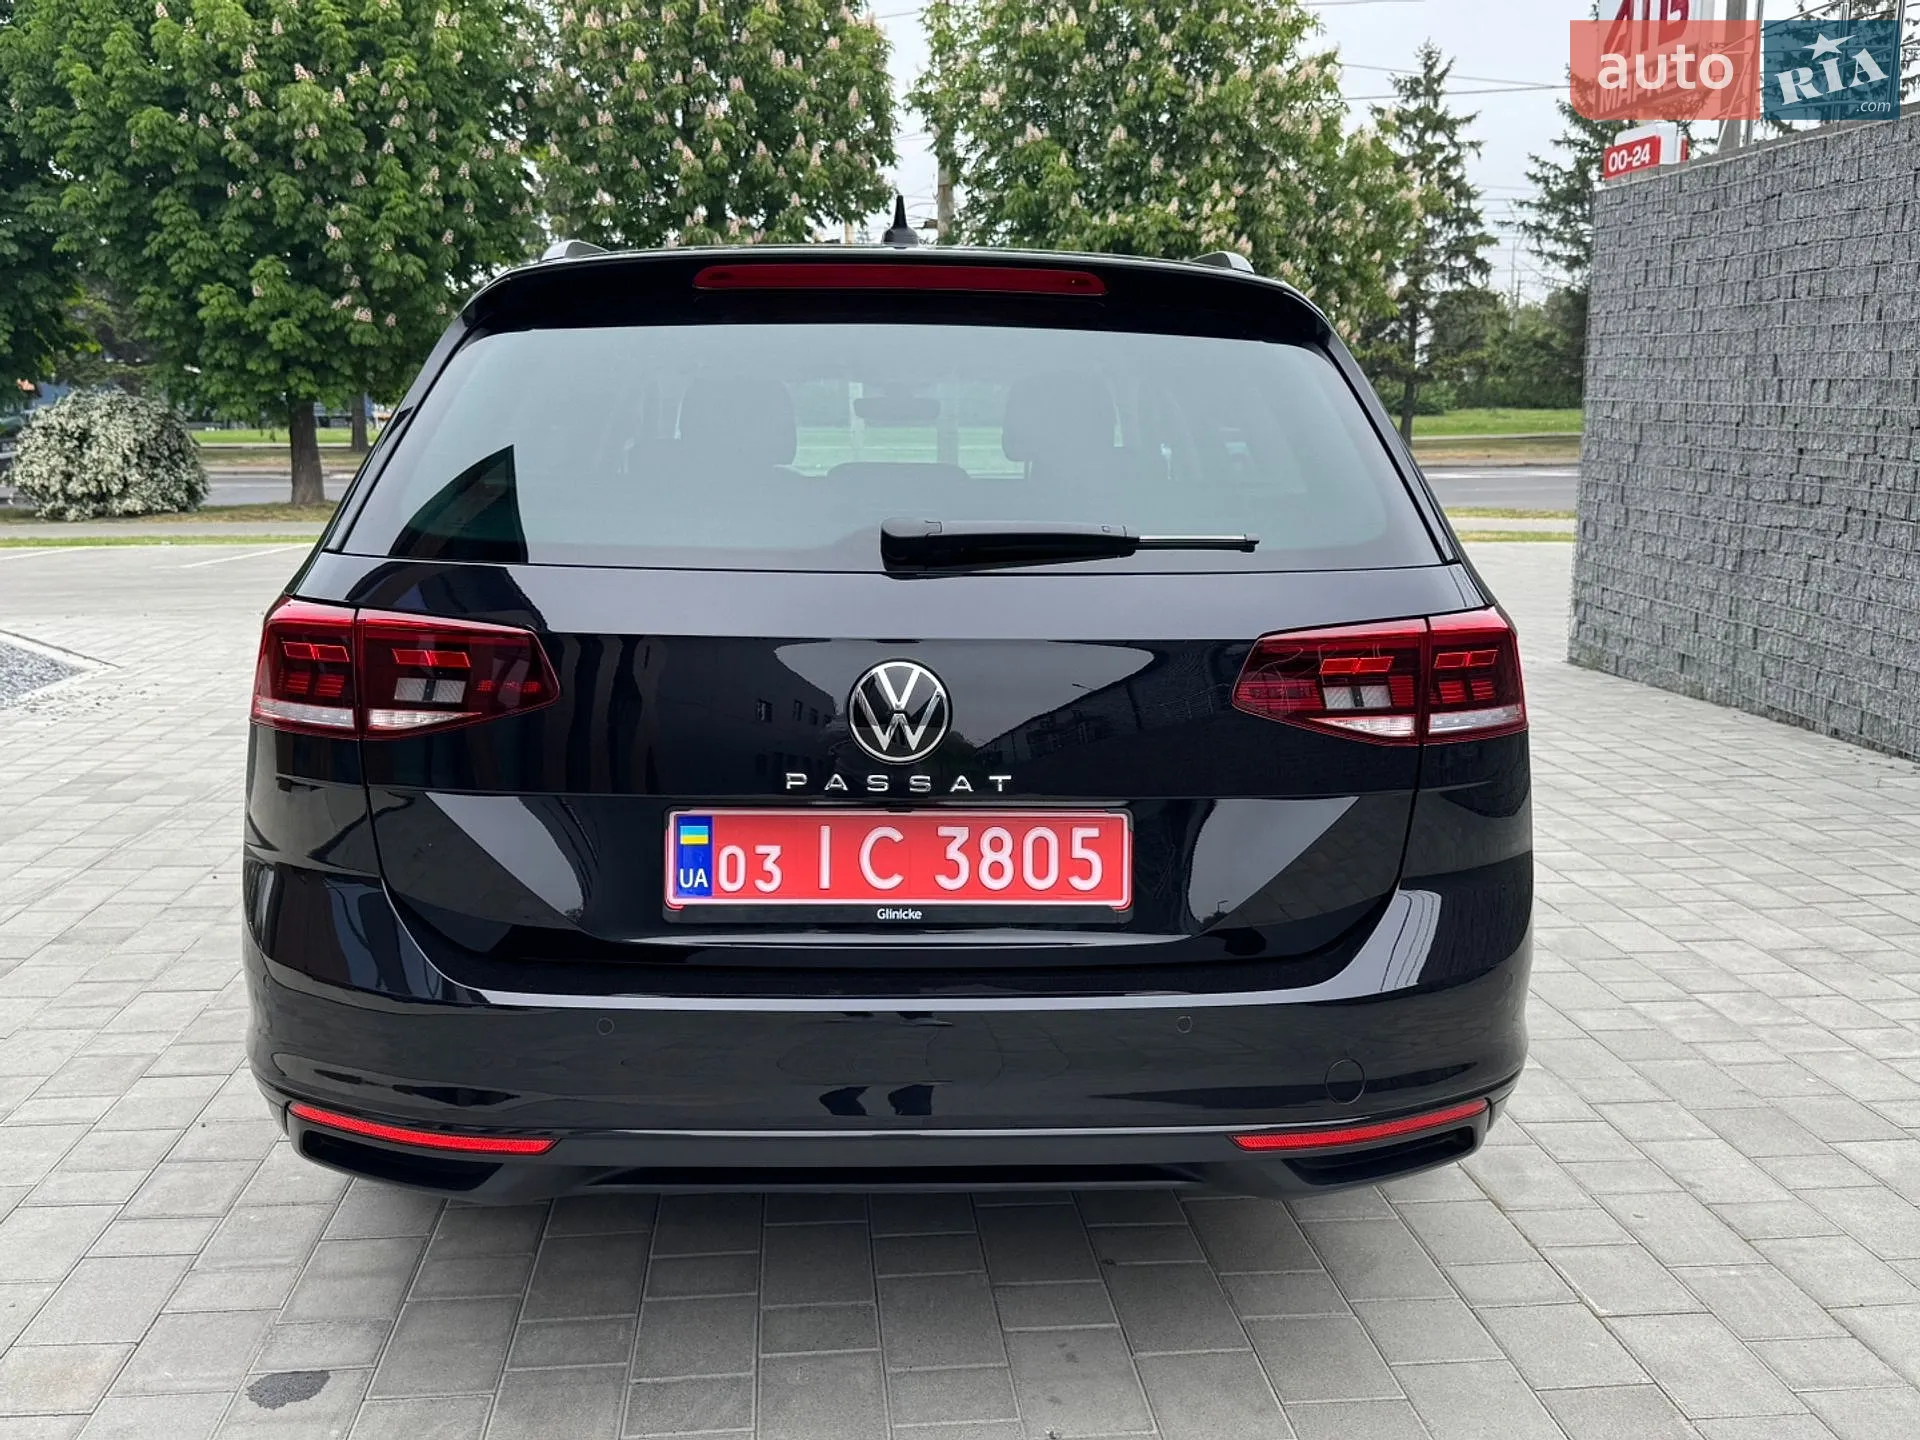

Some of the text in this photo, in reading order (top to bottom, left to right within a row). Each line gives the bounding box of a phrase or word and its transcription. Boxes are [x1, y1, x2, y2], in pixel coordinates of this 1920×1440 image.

[1608, 143, 1651, 173] 00-24
[785, 772, 1012, 793] PASSAT
[679, 868, 708, 888] UA
[717, 845, 783, 893] 03
[934, 825, 1103, 891] 3805
[877, 908, 922, 920] Glinicke
